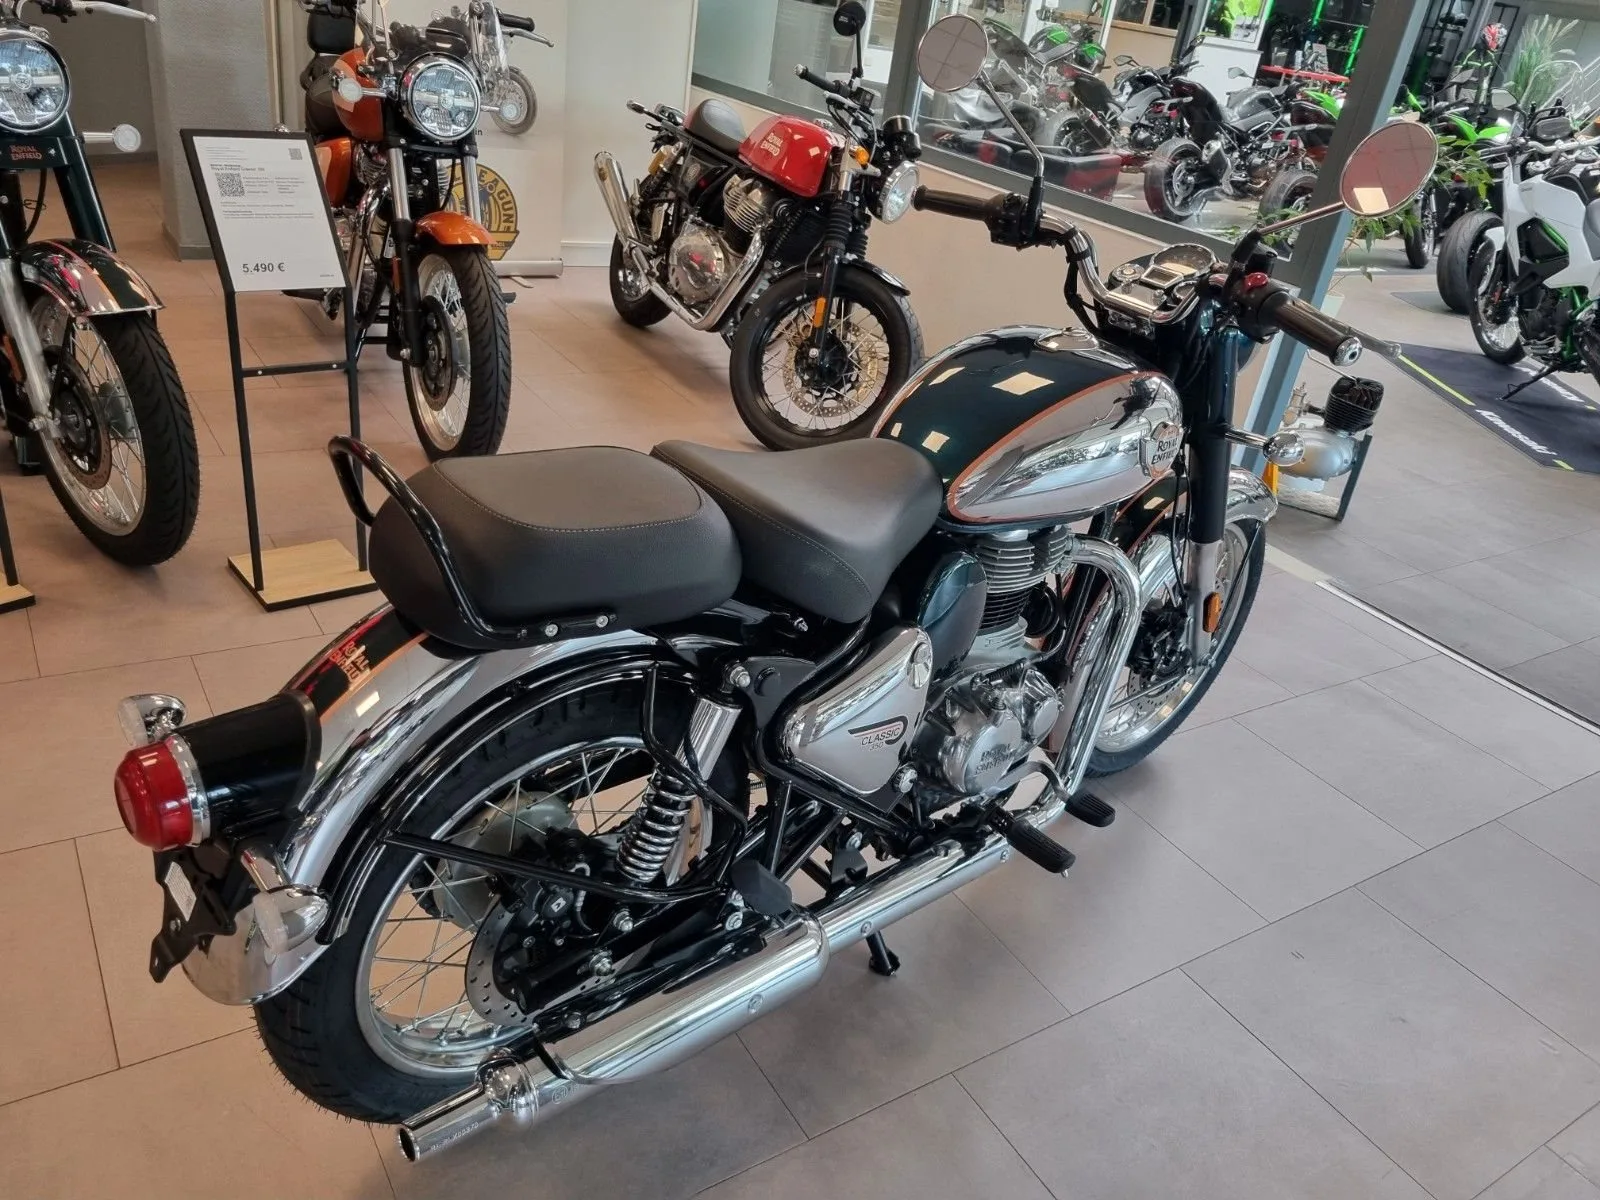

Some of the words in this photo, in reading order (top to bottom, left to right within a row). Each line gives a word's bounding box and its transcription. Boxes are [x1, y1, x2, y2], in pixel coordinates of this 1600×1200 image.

[767, 132, 783, 147] ROYAL
[496, 188, 514, 224] GUN
[242, 262, 274, 273] 5.490
[277, 262, 286, 272] €
[1157, 437, 1178, 452] ROYAL
[861, 727, 901, 746] CLASSIC
